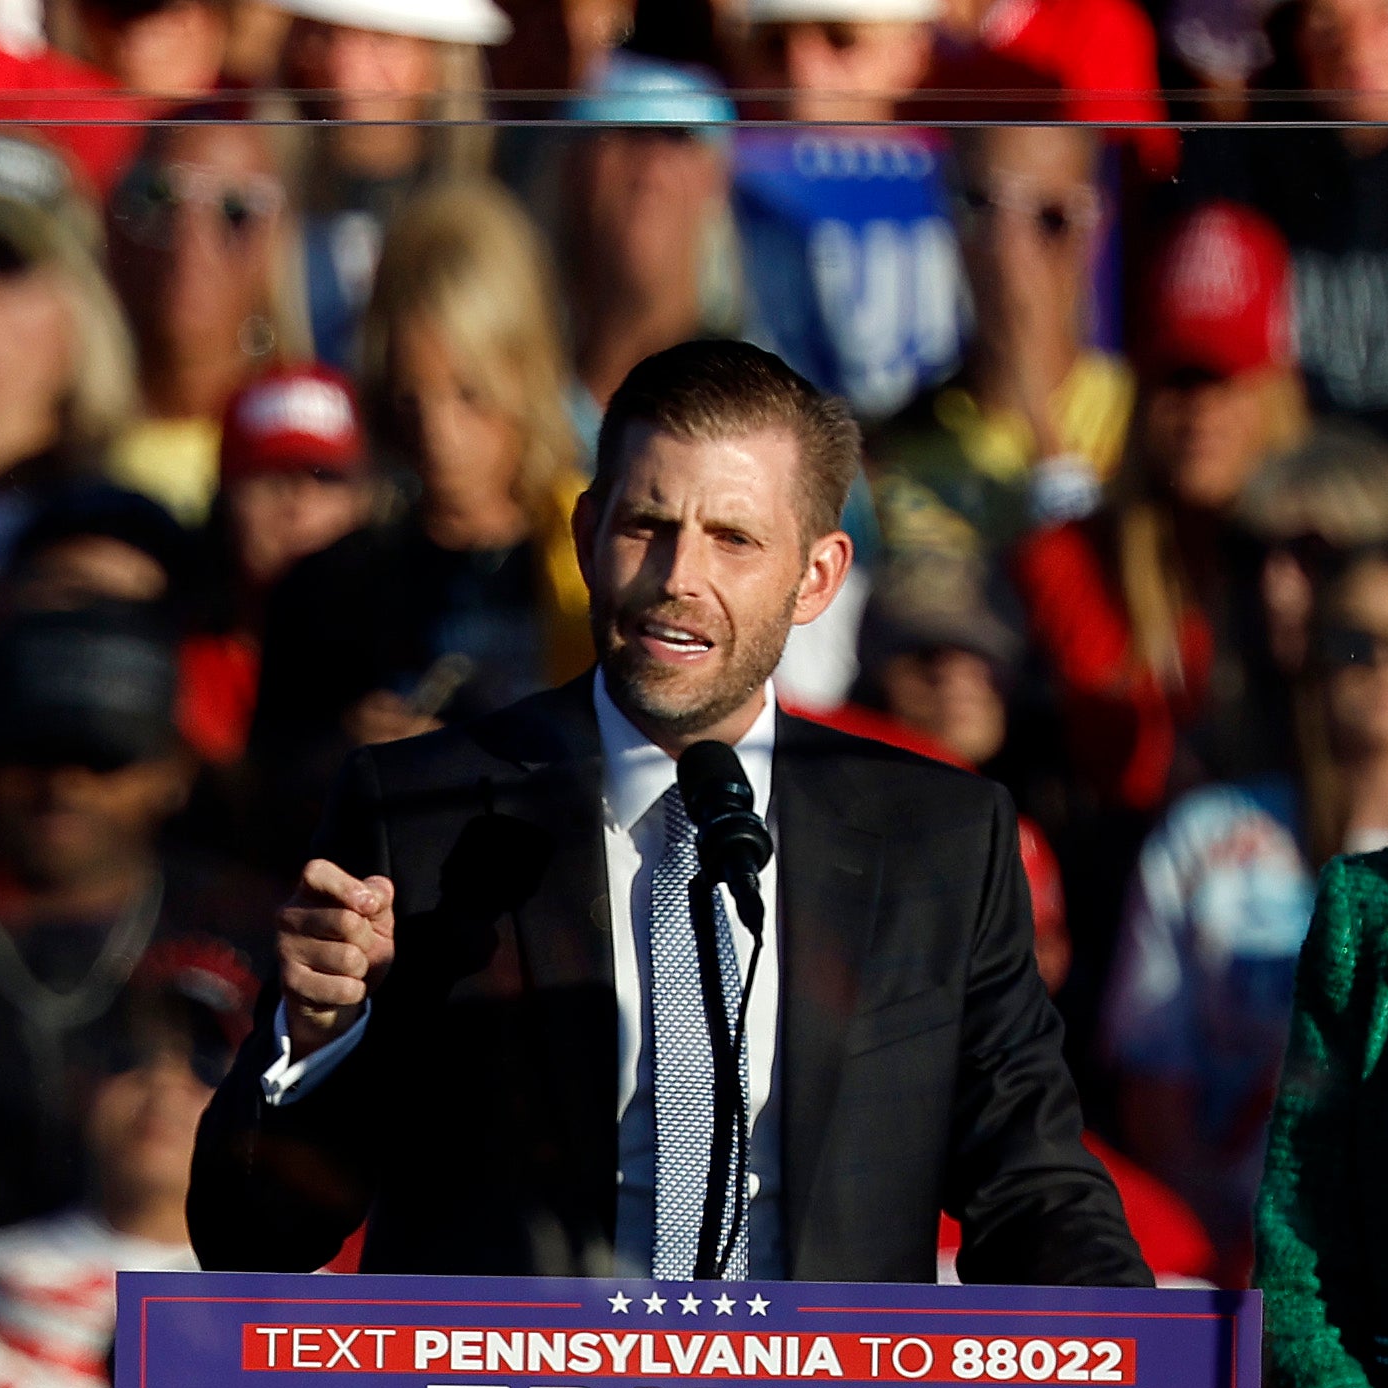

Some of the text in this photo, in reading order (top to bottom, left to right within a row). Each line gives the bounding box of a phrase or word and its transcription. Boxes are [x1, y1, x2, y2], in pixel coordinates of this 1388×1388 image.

[256, 1328, 1122, 1381] TEXT PENNSYLVANIA TO 88022
